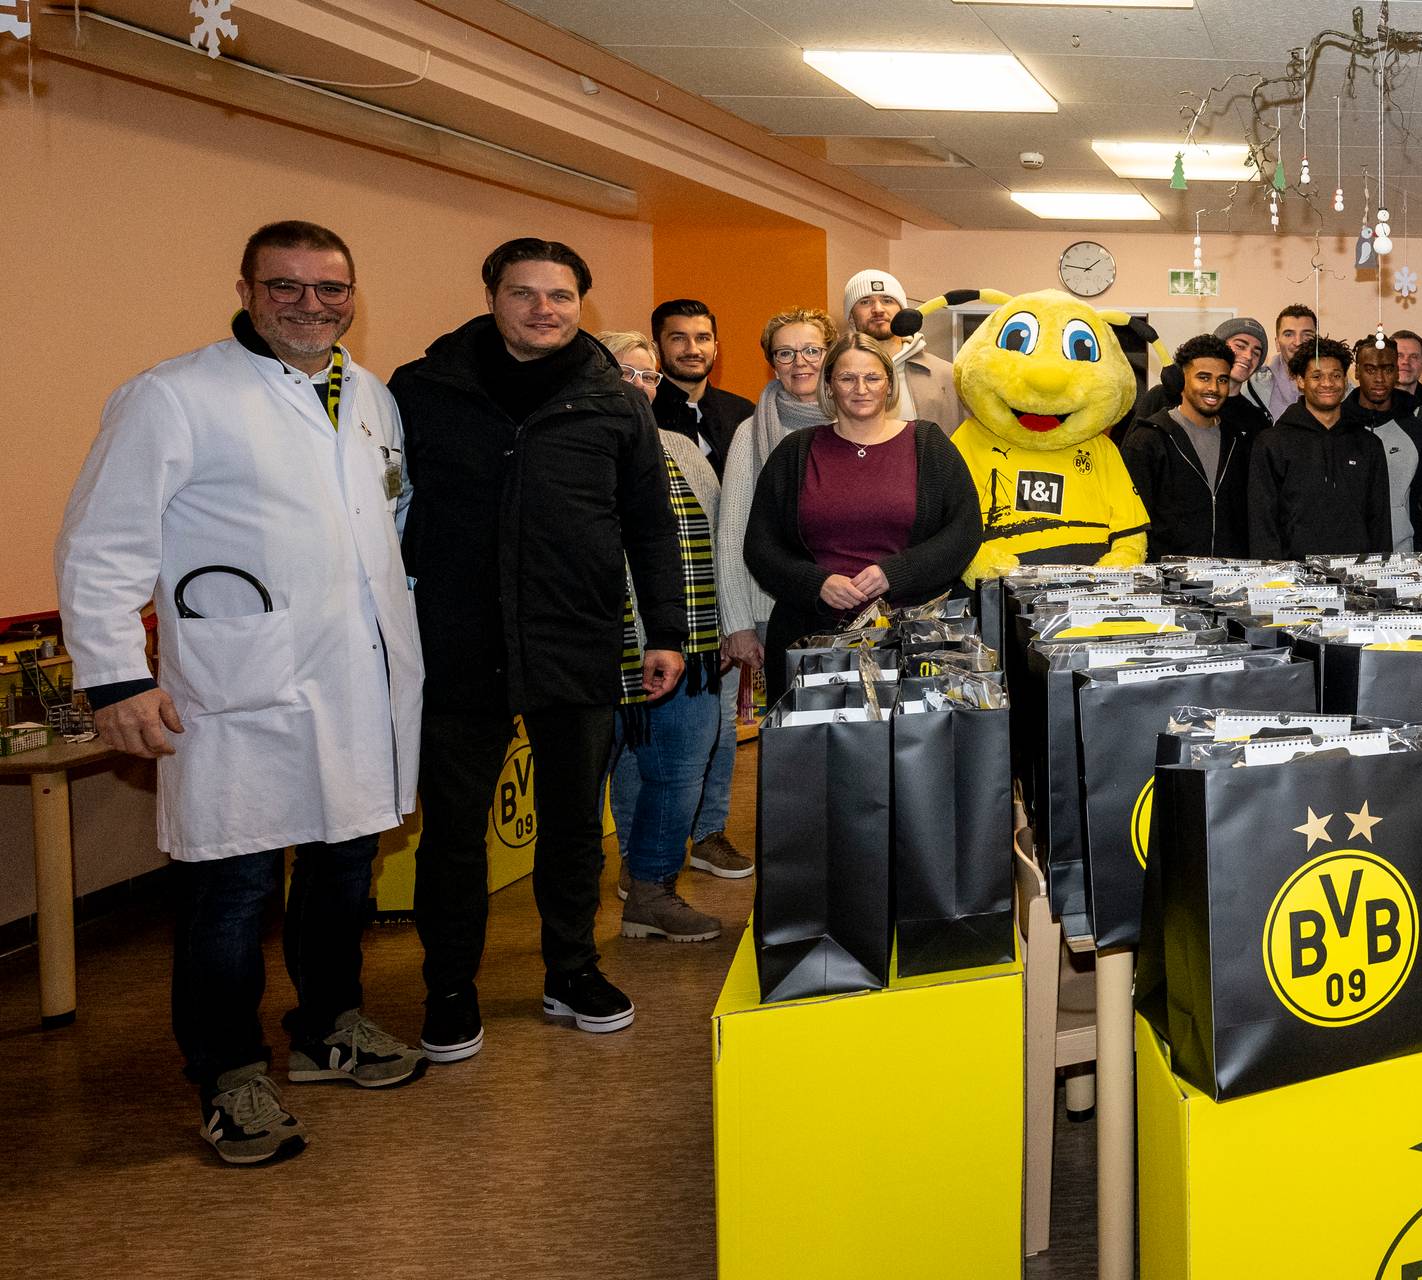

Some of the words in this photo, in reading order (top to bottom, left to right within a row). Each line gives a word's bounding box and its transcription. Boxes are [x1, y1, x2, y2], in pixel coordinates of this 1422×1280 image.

[1075, 456, 1091, 472] BVB
[1021, 479, 1059, 503] 1&1
[501, 752, 534, 826] BV
[515, 813, 534, 840] 09
[1289, 868, 1402, 979] BVB
[1325, 968, 1367, 1007] 09
